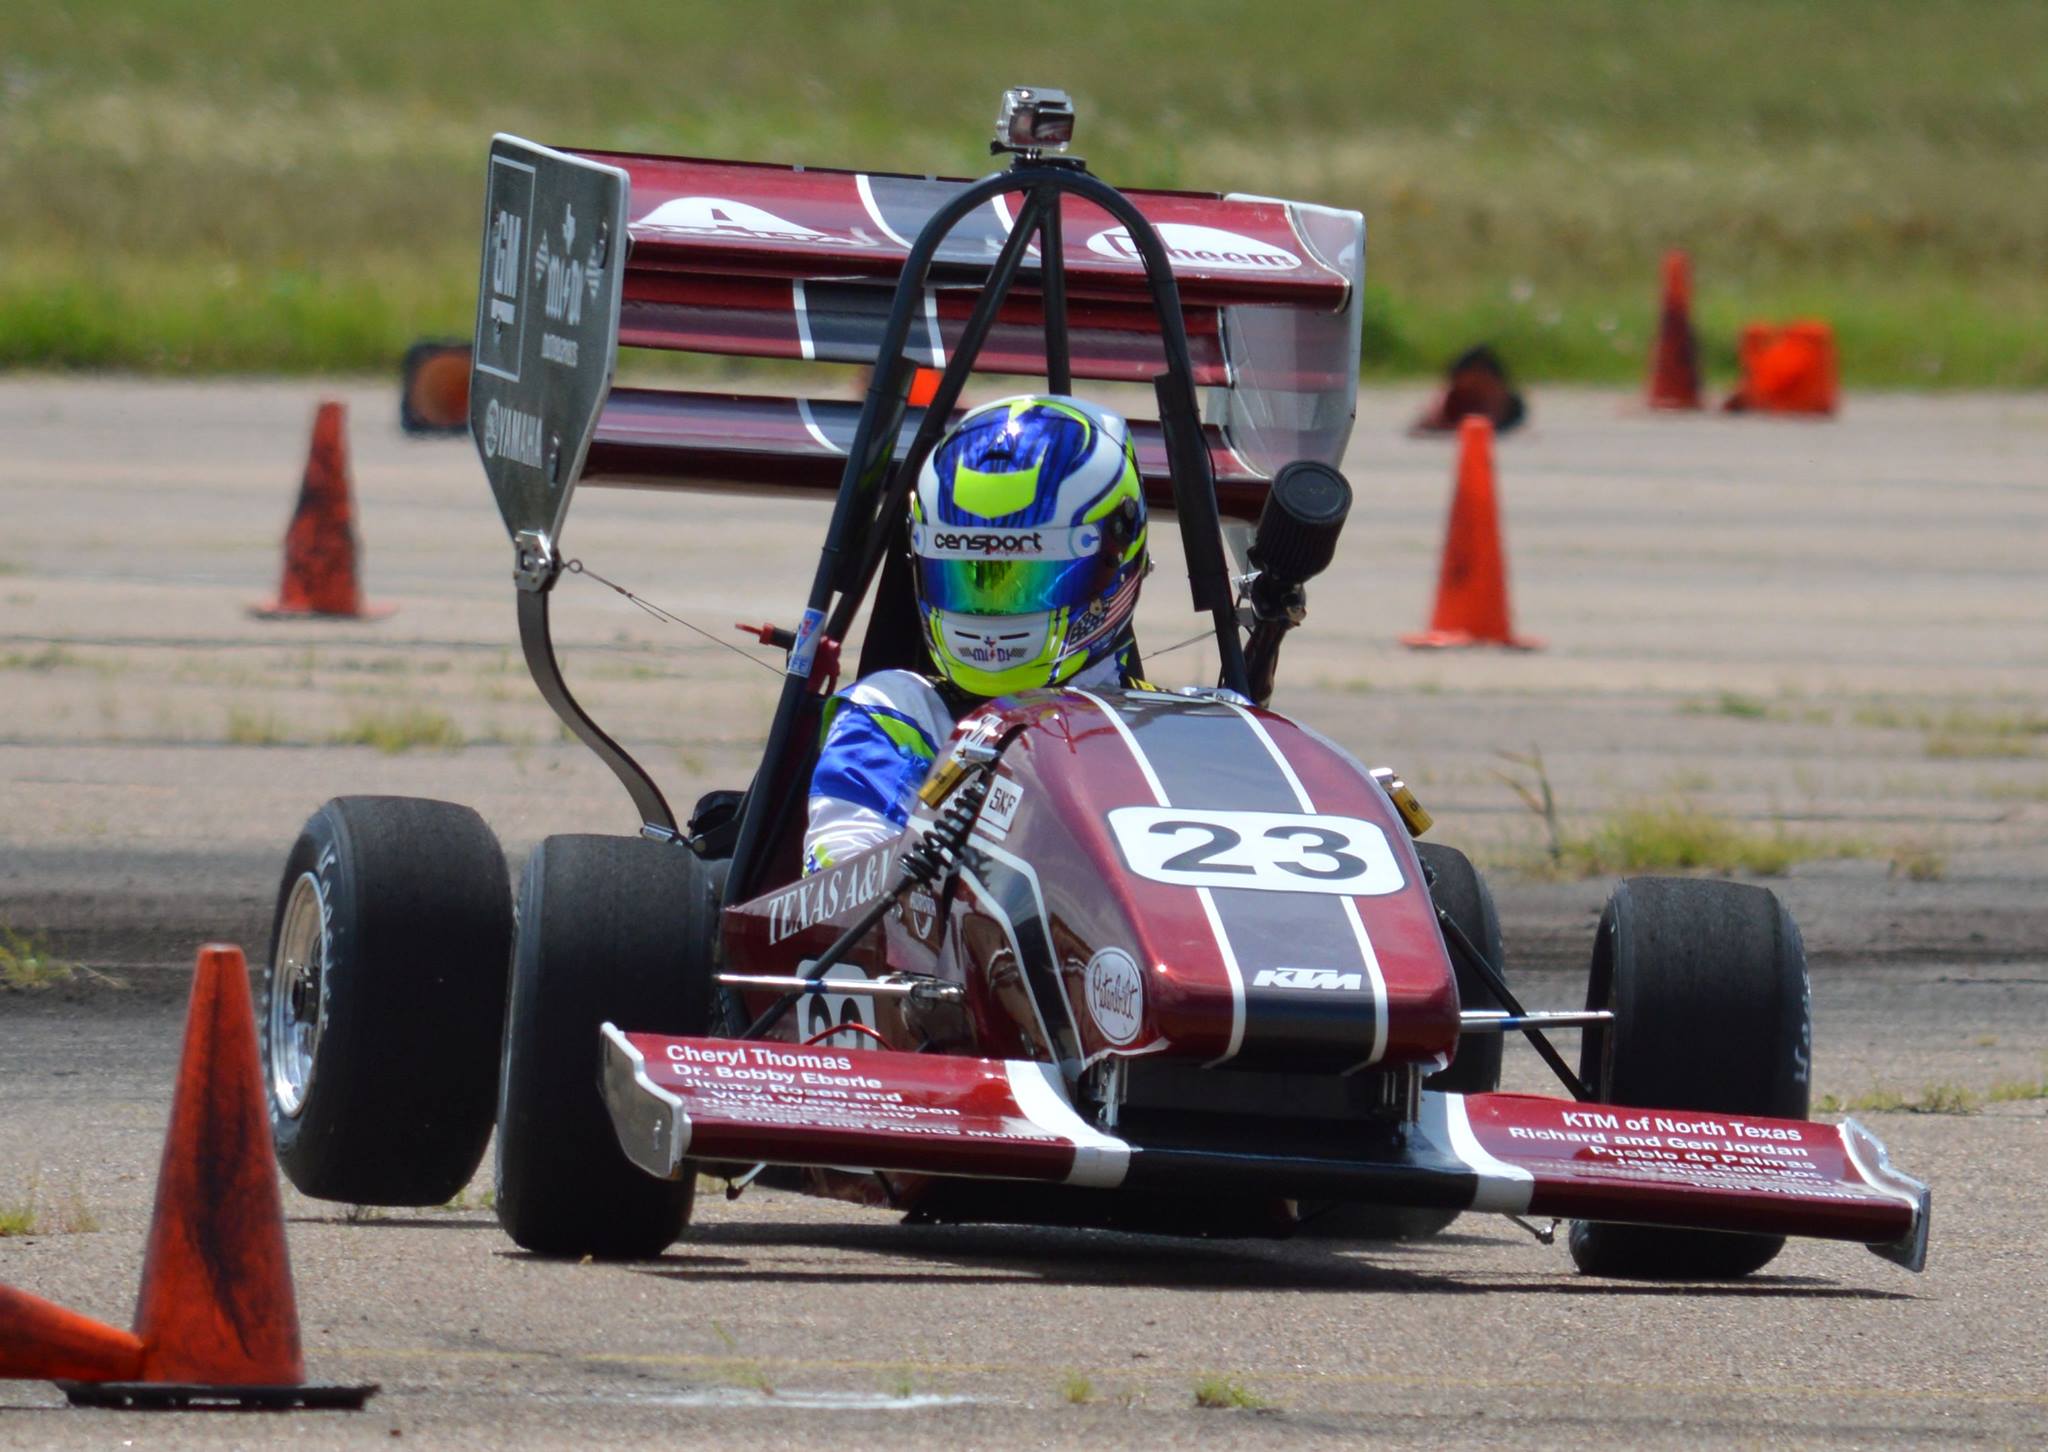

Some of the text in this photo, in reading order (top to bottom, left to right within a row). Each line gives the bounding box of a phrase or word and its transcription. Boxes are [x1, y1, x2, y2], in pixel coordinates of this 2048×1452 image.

[934, 532, 1042, 555] censport
[988, 787, 1017, 817] SKF
[1148, 820, 1368, 881] 23
[768, 871, 842, 946] TEXAS
[1252, 966, 1362, 991] KTM
[666, 1045, 852, 1070] Cheryl Thomas
[672, 1063, 882, 1089] Dr. Bobby Eberle
[684, 1078, 903, 1104] Jimmy Rosen and
[711, 1090, 775, 1102] Vicki
[778, 1095, 961, 1116] Weaver-Rosen
[1561, 1111, 1803, 1141] KTM of North Texas
[1508, 1127, 1809, 1157] Richard and Gen Jordan
[1589, 1145, 1817, 1170] Pueblo de Palmas
